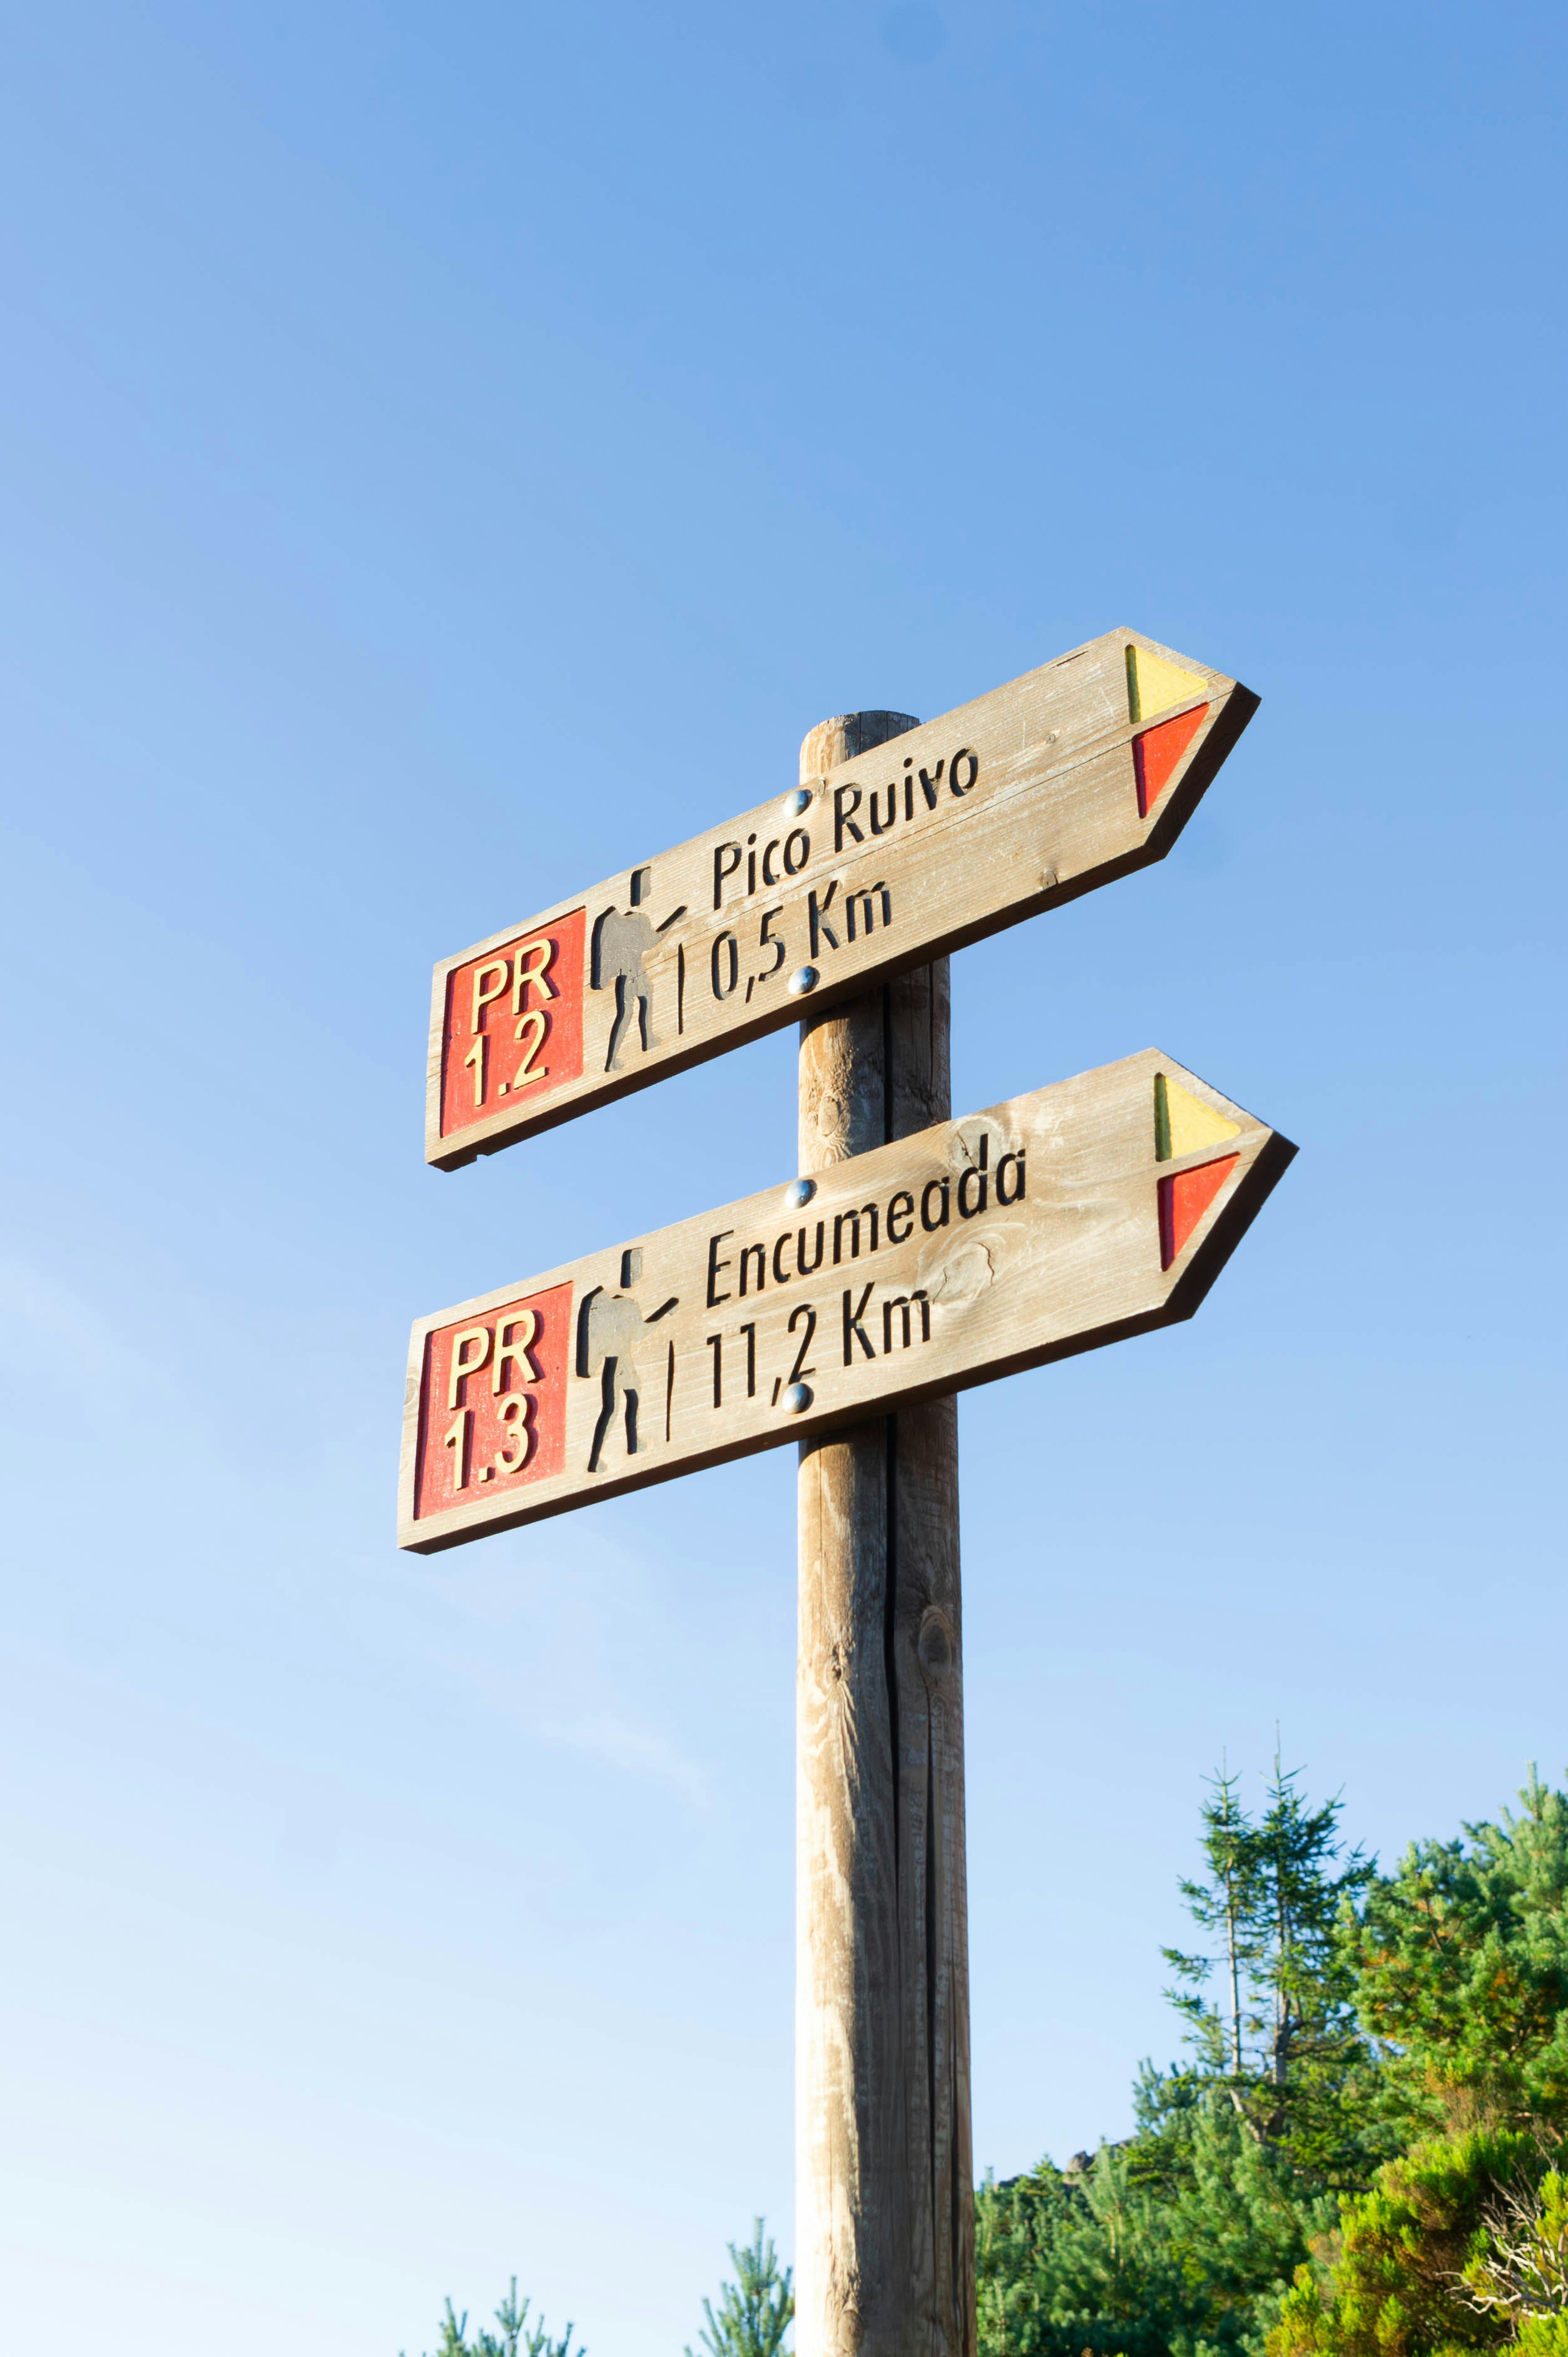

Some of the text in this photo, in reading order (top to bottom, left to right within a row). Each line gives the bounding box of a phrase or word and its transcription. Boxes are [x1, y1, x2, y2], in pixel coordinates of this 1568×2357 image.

[713, 747, 979, 911] Pico Ruivo
[471, 938, 556, 1035] PR
[711, 880, 892, 1003] 0,5 Km
[464, 1010, 549, 1107] 1.2
[706, 1133, 1026, 1309] Encumeada
[448, 1309, 539, 1411] PR
[706, 1281, 931, 1408] 11,2 Km
[444, 1392, 531, 1491] 1.3
